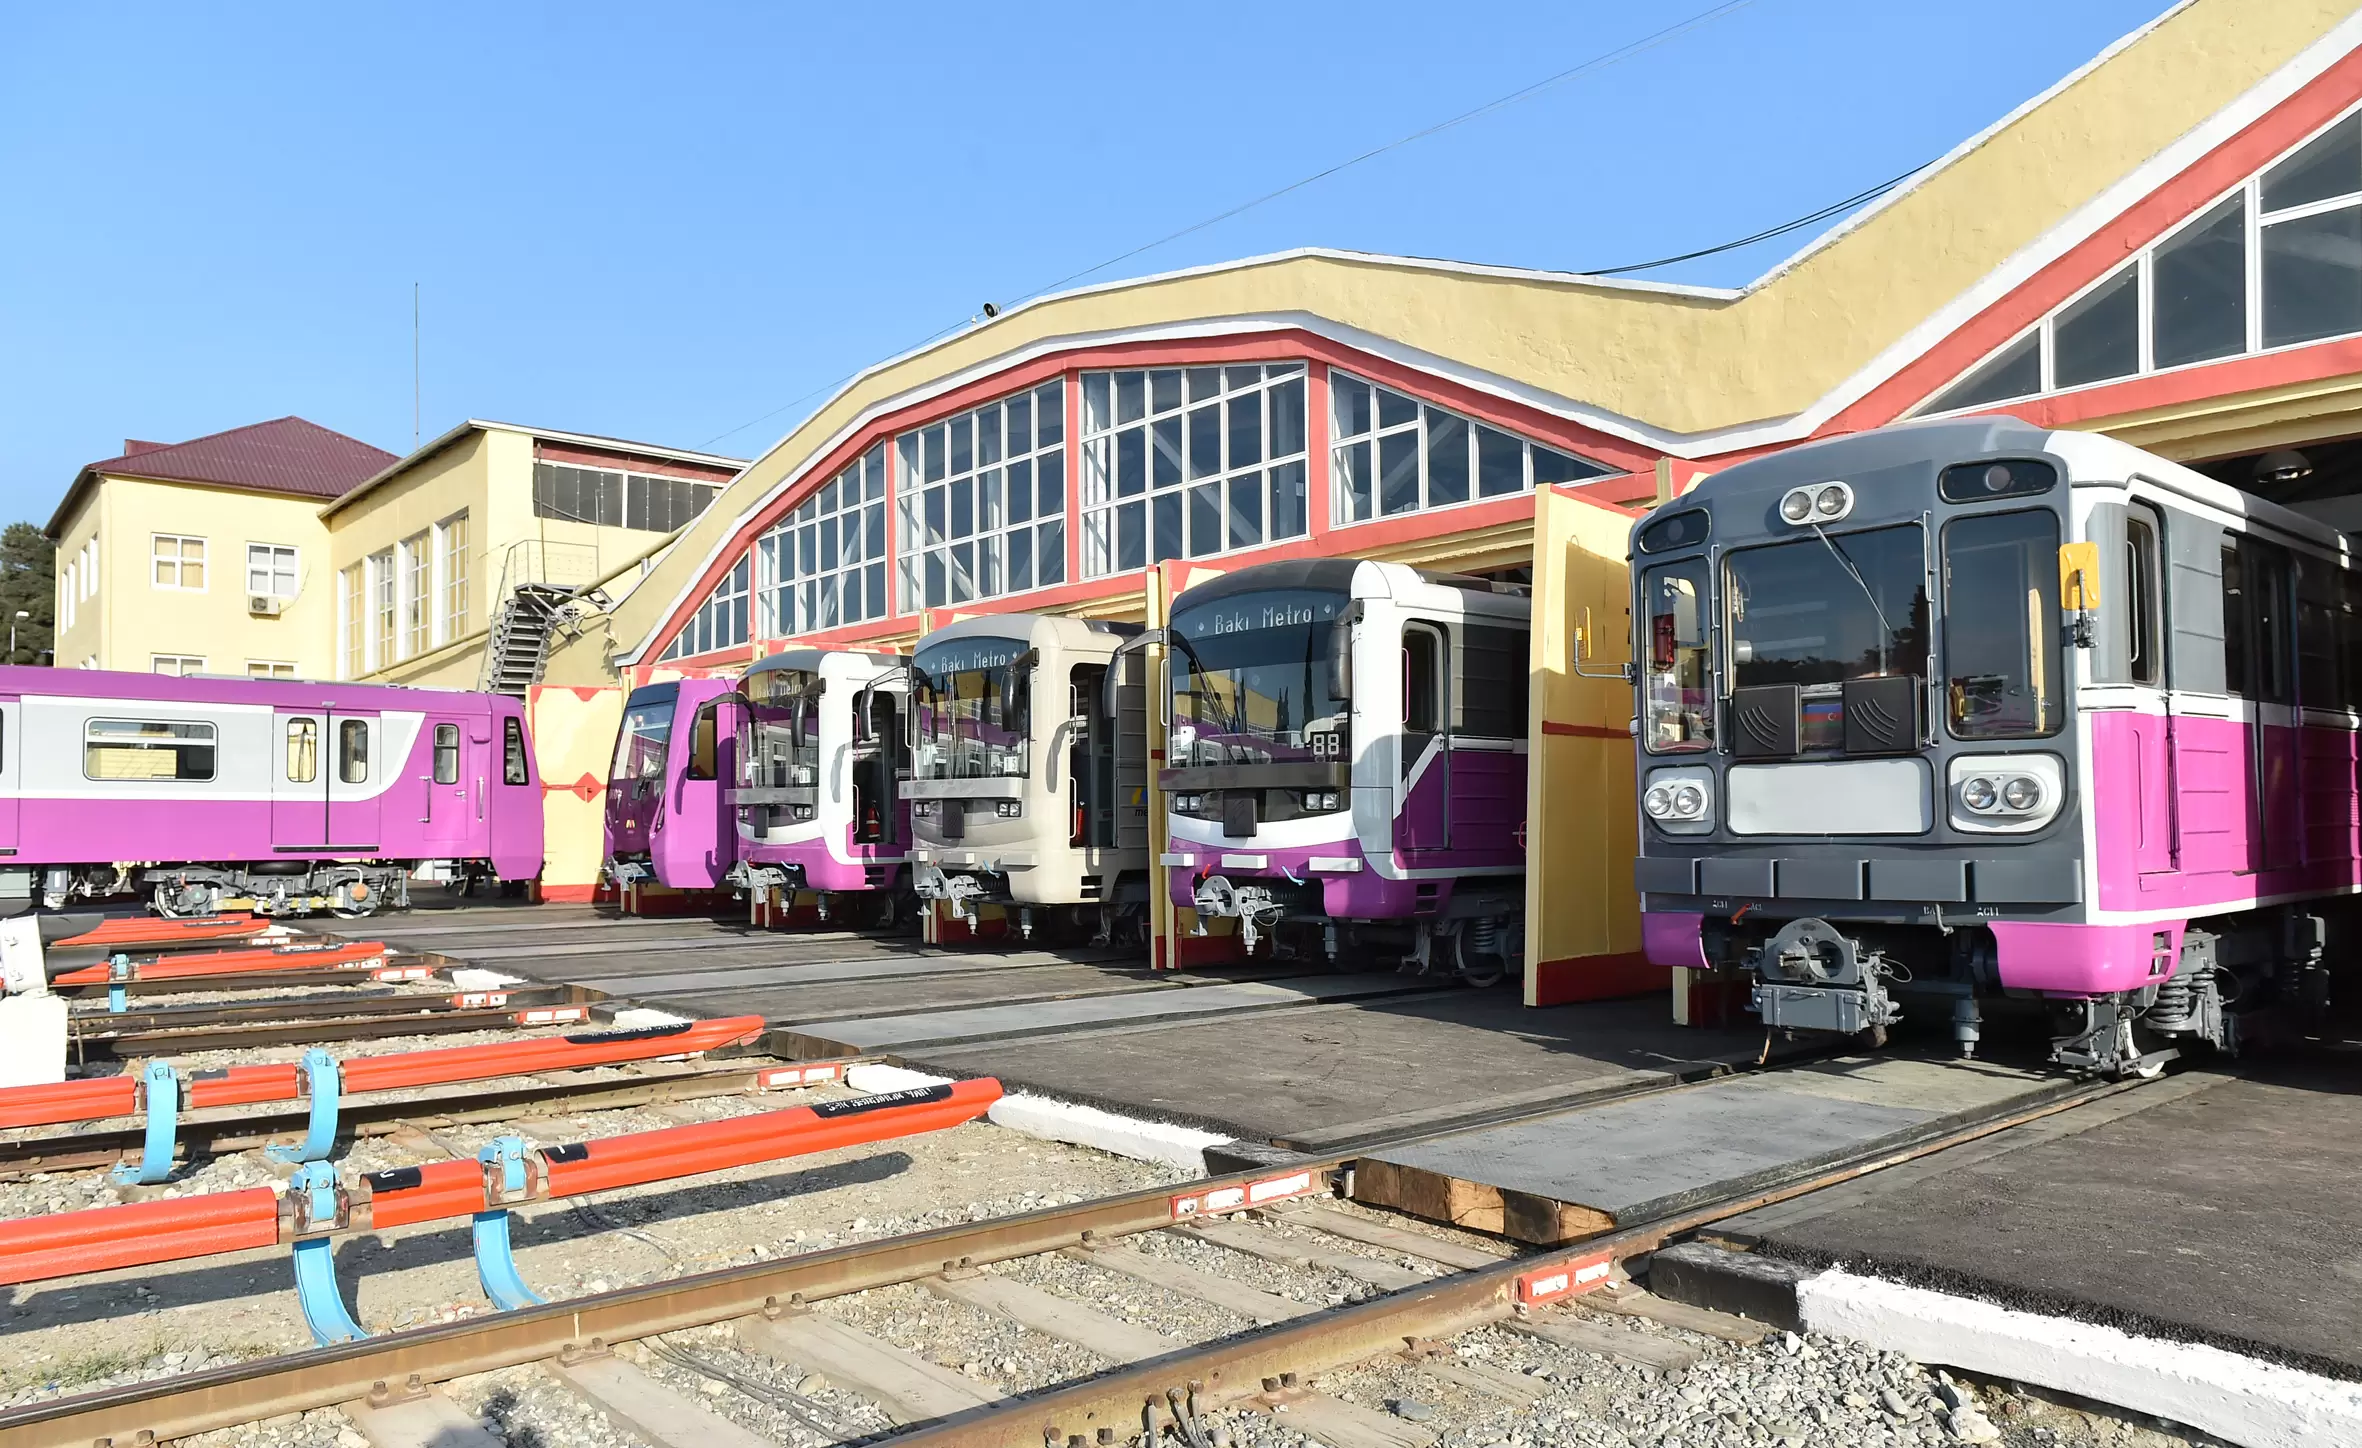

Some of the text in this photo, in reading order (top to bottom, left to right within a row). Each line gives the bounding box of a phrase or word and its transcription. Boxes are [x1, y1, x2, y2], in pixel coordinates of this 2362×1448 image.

[1214, 604, 1312, 635] Bakı Metro
[941, 650, 1006, 673] Bakı Metro
[1313, 733, 1340, 756] 88
